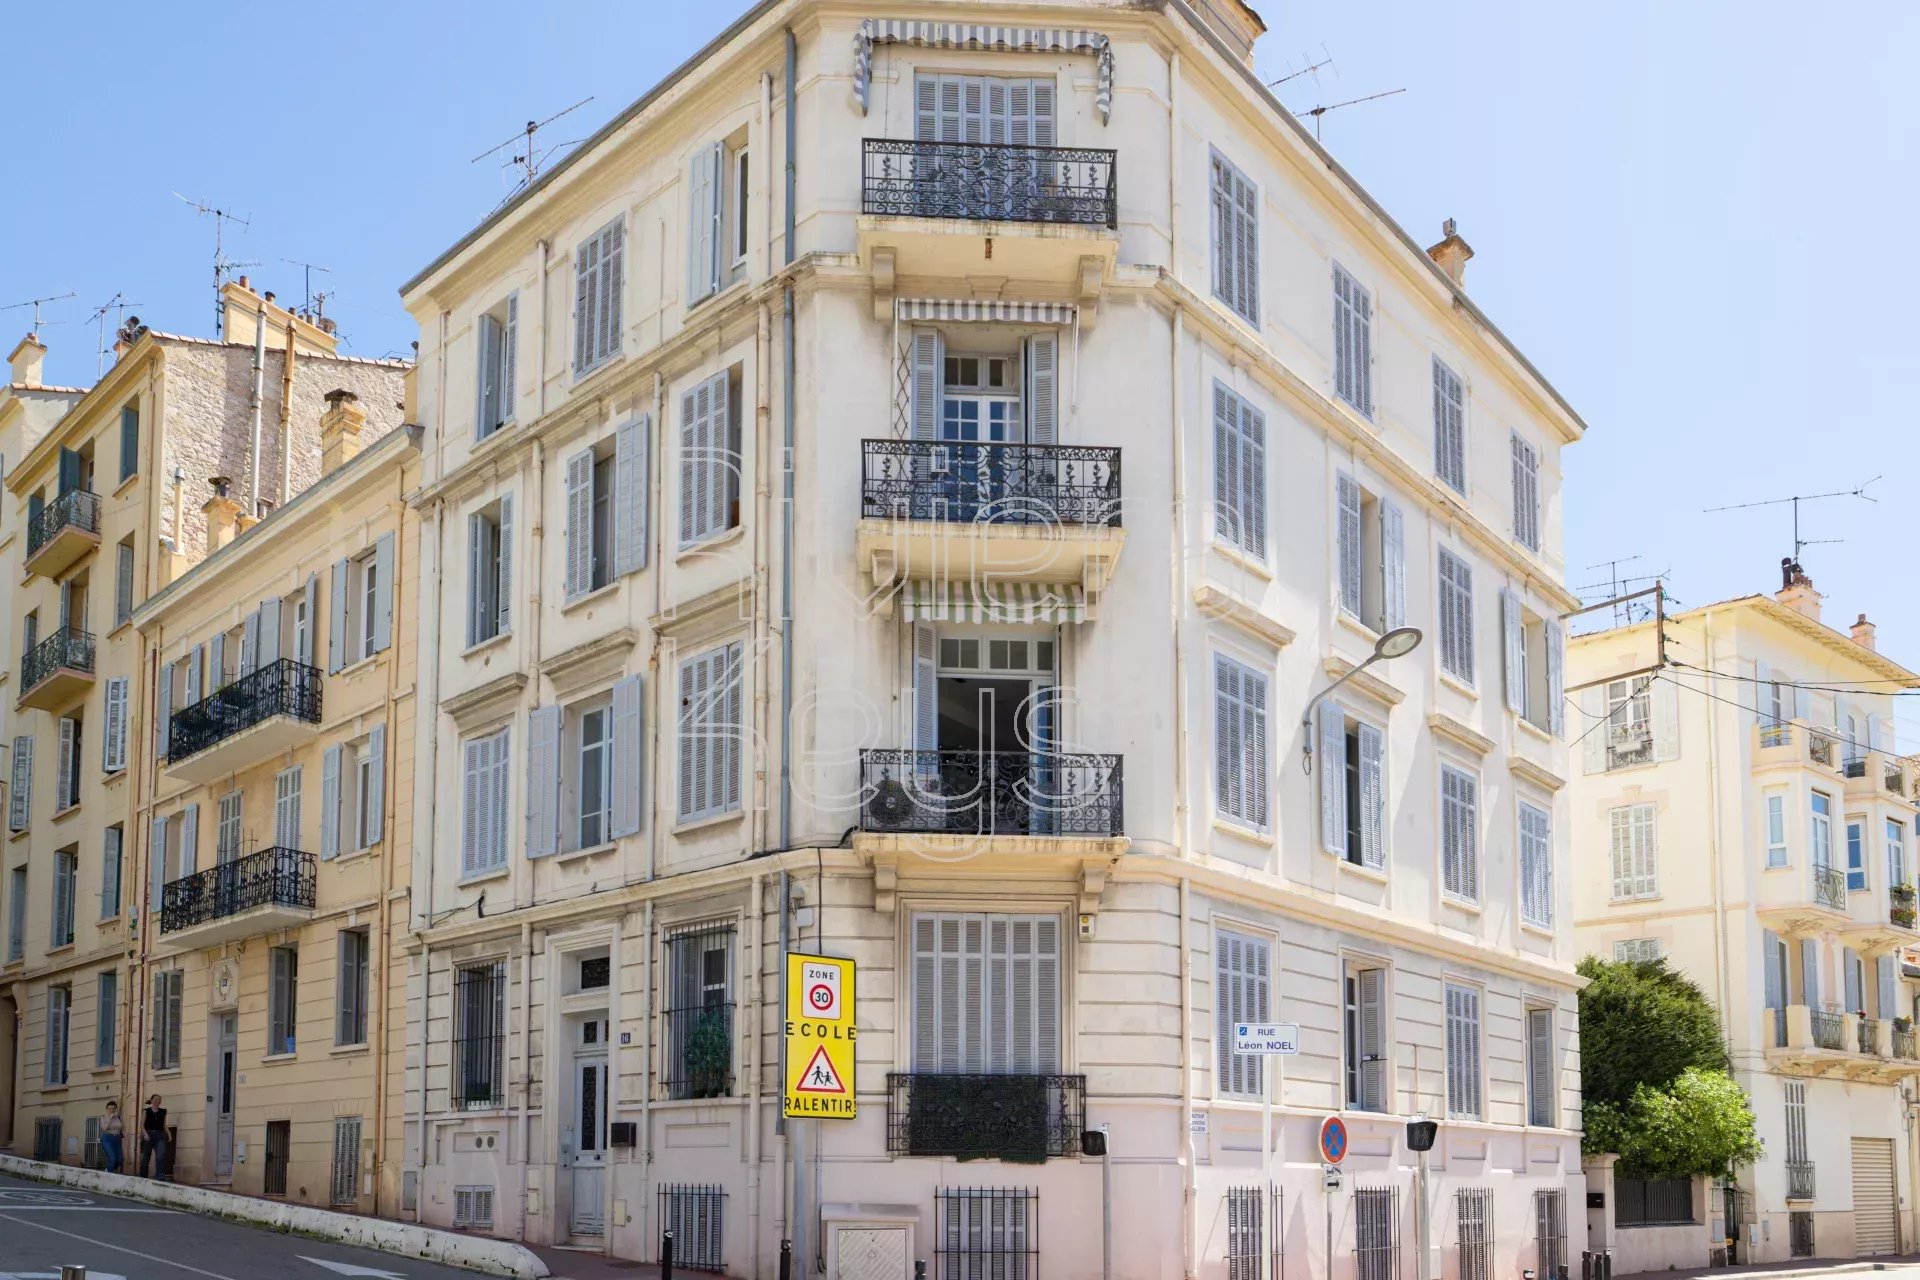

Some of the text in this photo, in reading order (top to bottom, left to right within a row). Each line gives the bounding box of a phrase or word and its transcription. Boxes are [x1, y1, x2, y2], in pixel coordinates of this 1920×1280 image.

[809, 969, 834, 980] ZONE
[814, 991, 828, 1003] 30
[785, 1021, 856, 1040] ECOLE
[1257, 1028, 1275, 1036] RUE
[1238, 1041, 1294, 1050] Léon NOEL
[784, 1097, 857, 1113] RALENTIR!
